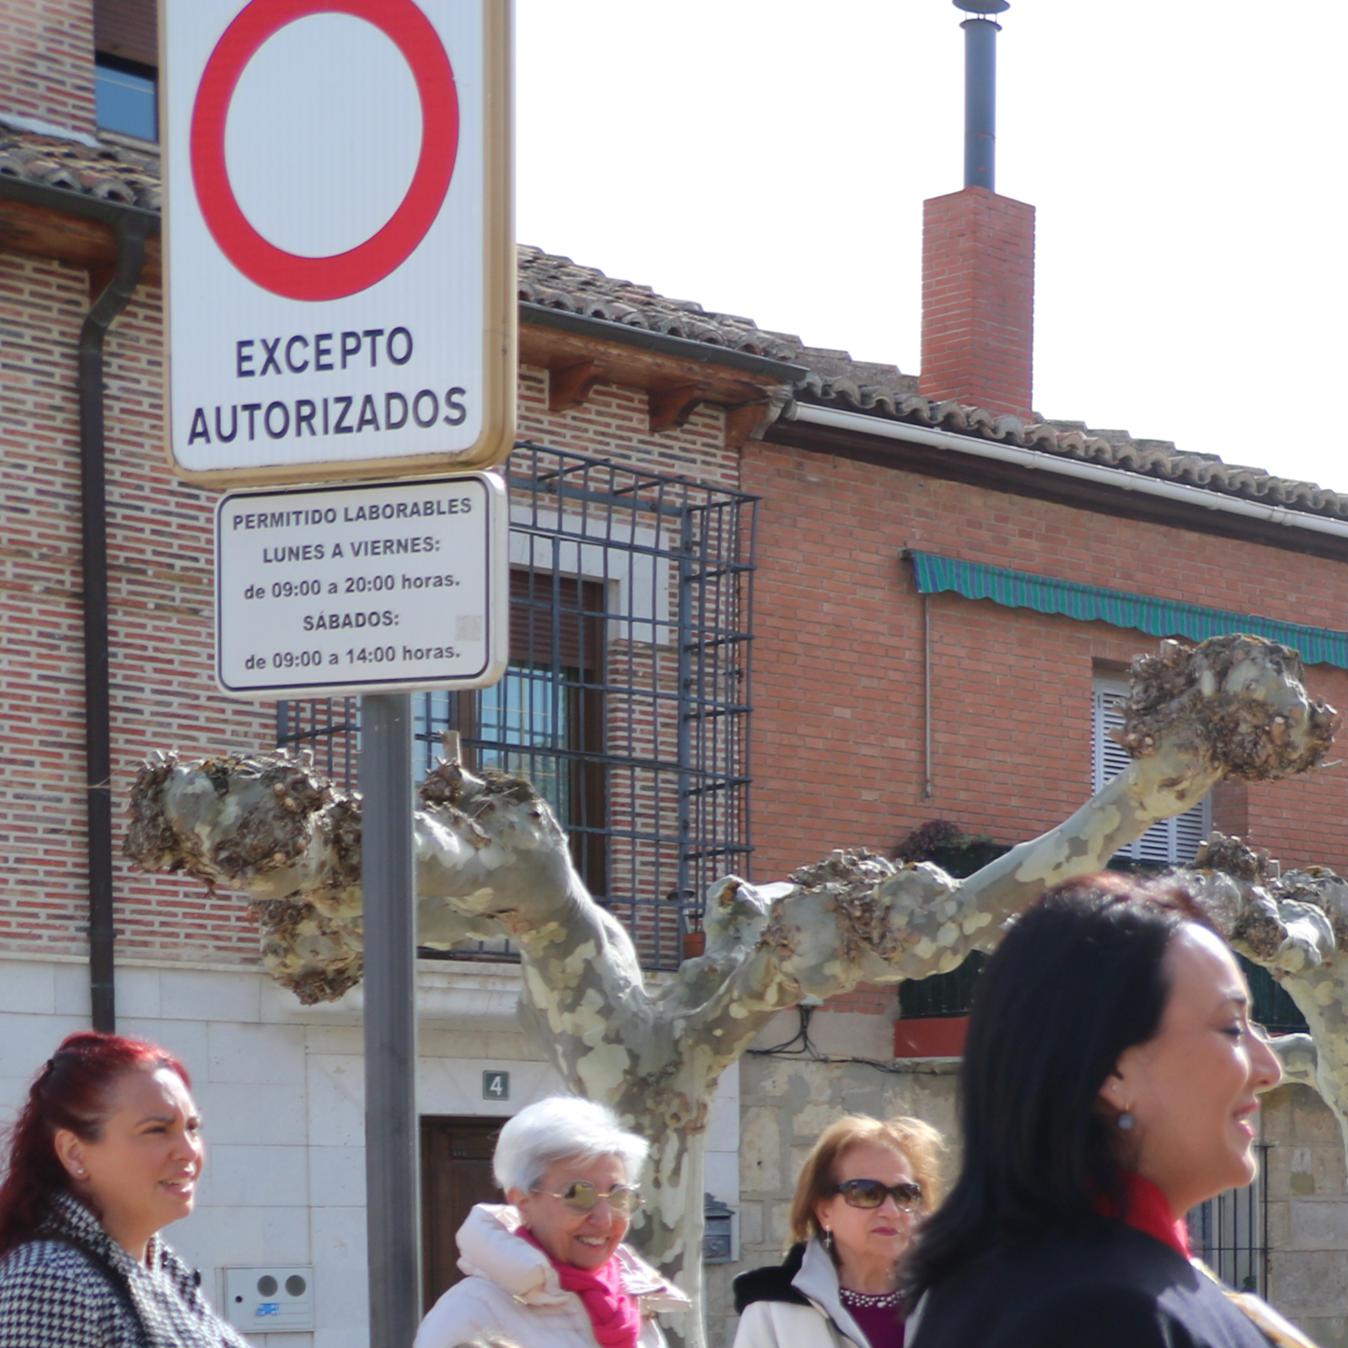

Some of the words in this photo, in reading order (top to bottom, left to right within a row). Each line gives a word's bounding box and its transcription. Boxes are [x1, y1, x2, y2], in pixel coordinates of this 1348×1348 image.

[235, 325, 414, 379] EXCEPTO
[187, 385, 468, 446] AUTORIZADOS
[232, 508, 337, 531] PERMITIDO
[343, 497, 473, 524] LABORABLES
[262, 543, 325, 564] LUNES
[330, 543, 345, 560] A
[349, 535, 441, 558] VIERNES:
[243, 583, 266, 601] de
[271, 579, 322, 599] 09:00
[327, 581, 339, 595] a
[344, 574, 396, 594] 20:00
[401, 572, 461, 590] horas.
[302, 609, 400, 632] SÁBADOS:
[244, 653, 267, 671] de
[272, 650, 323, 670] 09:00
[327, 652, 340, 666] a
[345, 645, 397, 664] 14:00
[401, 644, 461, 662] horas.
[489, 1075, 504, 1097] 4
